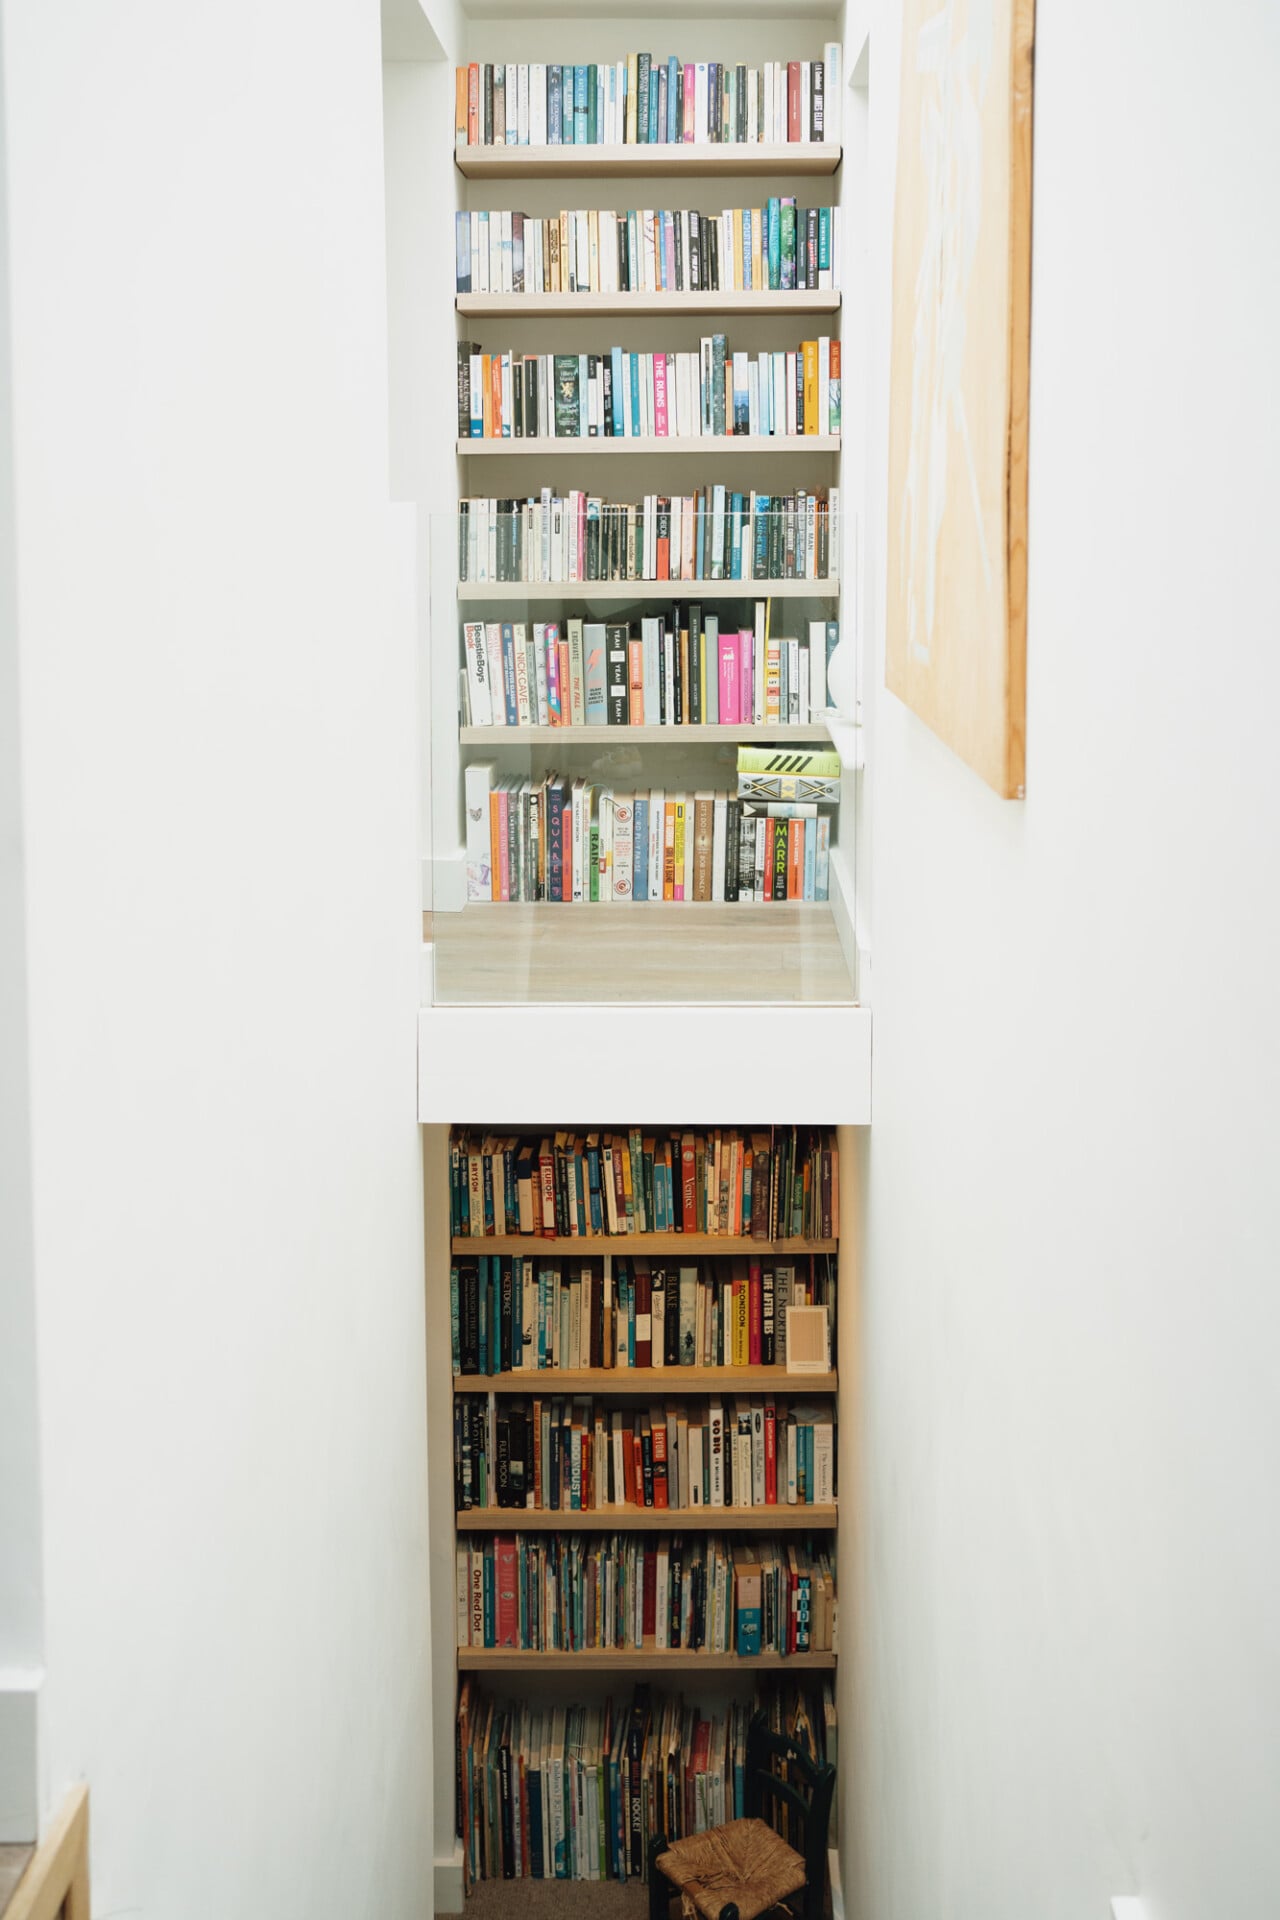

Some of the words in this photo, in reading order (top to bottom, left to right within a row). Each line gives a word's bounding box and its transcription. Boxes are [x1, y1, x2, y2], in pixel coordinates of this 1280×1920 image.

[656, 360, 664, 378] THE
[657, 380, 665, 408] RUINS
[466, 625, 475, 649] Book
[474, 625, 486, 683] BeastieBoys
[516, 652, 525, 674] NICK
[518, 677, 528, 704] CAVE
[591, 833, 599, 866] RAIN
[665, 847, 674, 858] GIRL
[775, 825, 788, 873] MARR
[699, 855, 707, 868] BOB
[665, 870, 674, 884] BAND
[699, 869, 707, 893] STANLEY
[544, 1168, 553, 1202] EUROPE
[686, 1177, 695, 1208] Venice
[667, 1276, 677, 1309] BLAKE
[763, 1273, 774, 1291] LIFE
[778, 1271, 788, 1294] THE
[763, 1292, 774, 1318] AFTER
[778, 1298, 788, 1343] NORTH
[713, 1419, 721, 1435] GO
[499, 1440, 507, 1458] FULL
[655, 1433, 664, 1459] BEYOND
[713, 1436, 721, 1455] BIG
[500, 1460, 508, 1488] MOON
[571, 1435, 581, 1498] MOONDUST
[473, 1569, 482, 1590] One
[474, 1591, 482, 1612] Red
[474, 1613, 482, 1633] Dot
[632, 1797, 641, 1833] ROCKET
